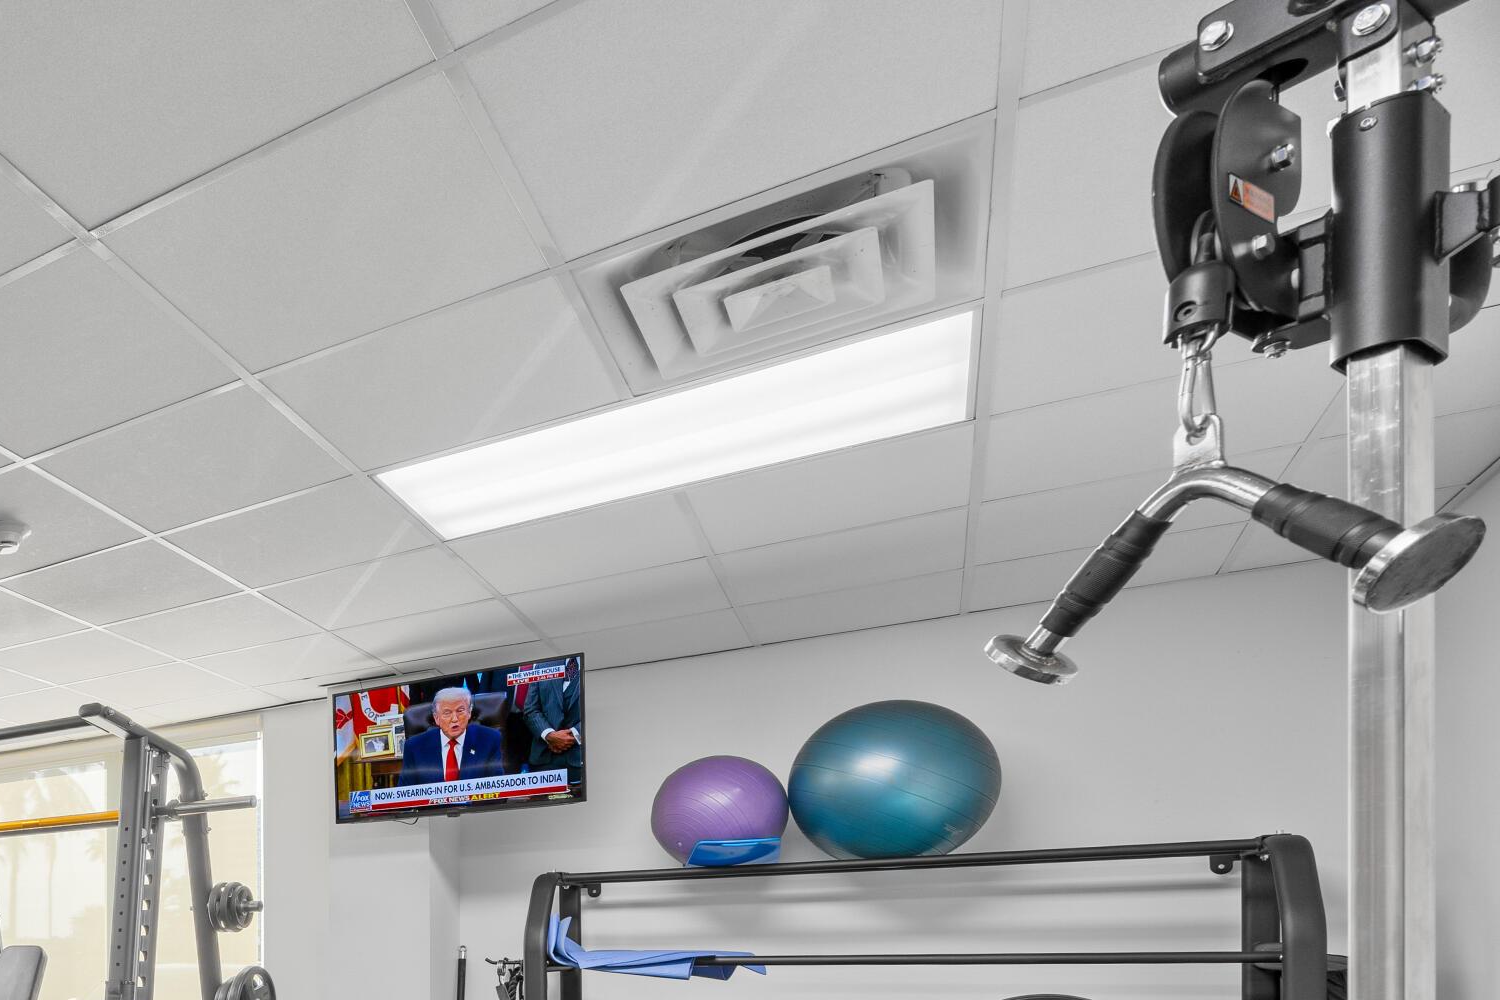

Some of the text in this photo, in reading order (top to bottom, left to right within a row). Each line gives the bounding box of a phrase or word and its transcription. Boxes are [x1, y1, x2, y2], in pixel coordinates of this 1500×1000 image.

[374, 773, 563, 801] NOW: SWEARING-IN FOR U.S. AMBASSADOR TO INDIA
[448, 795, 470, 803] NEWS
[470, 792, 500, 800] ALERT
